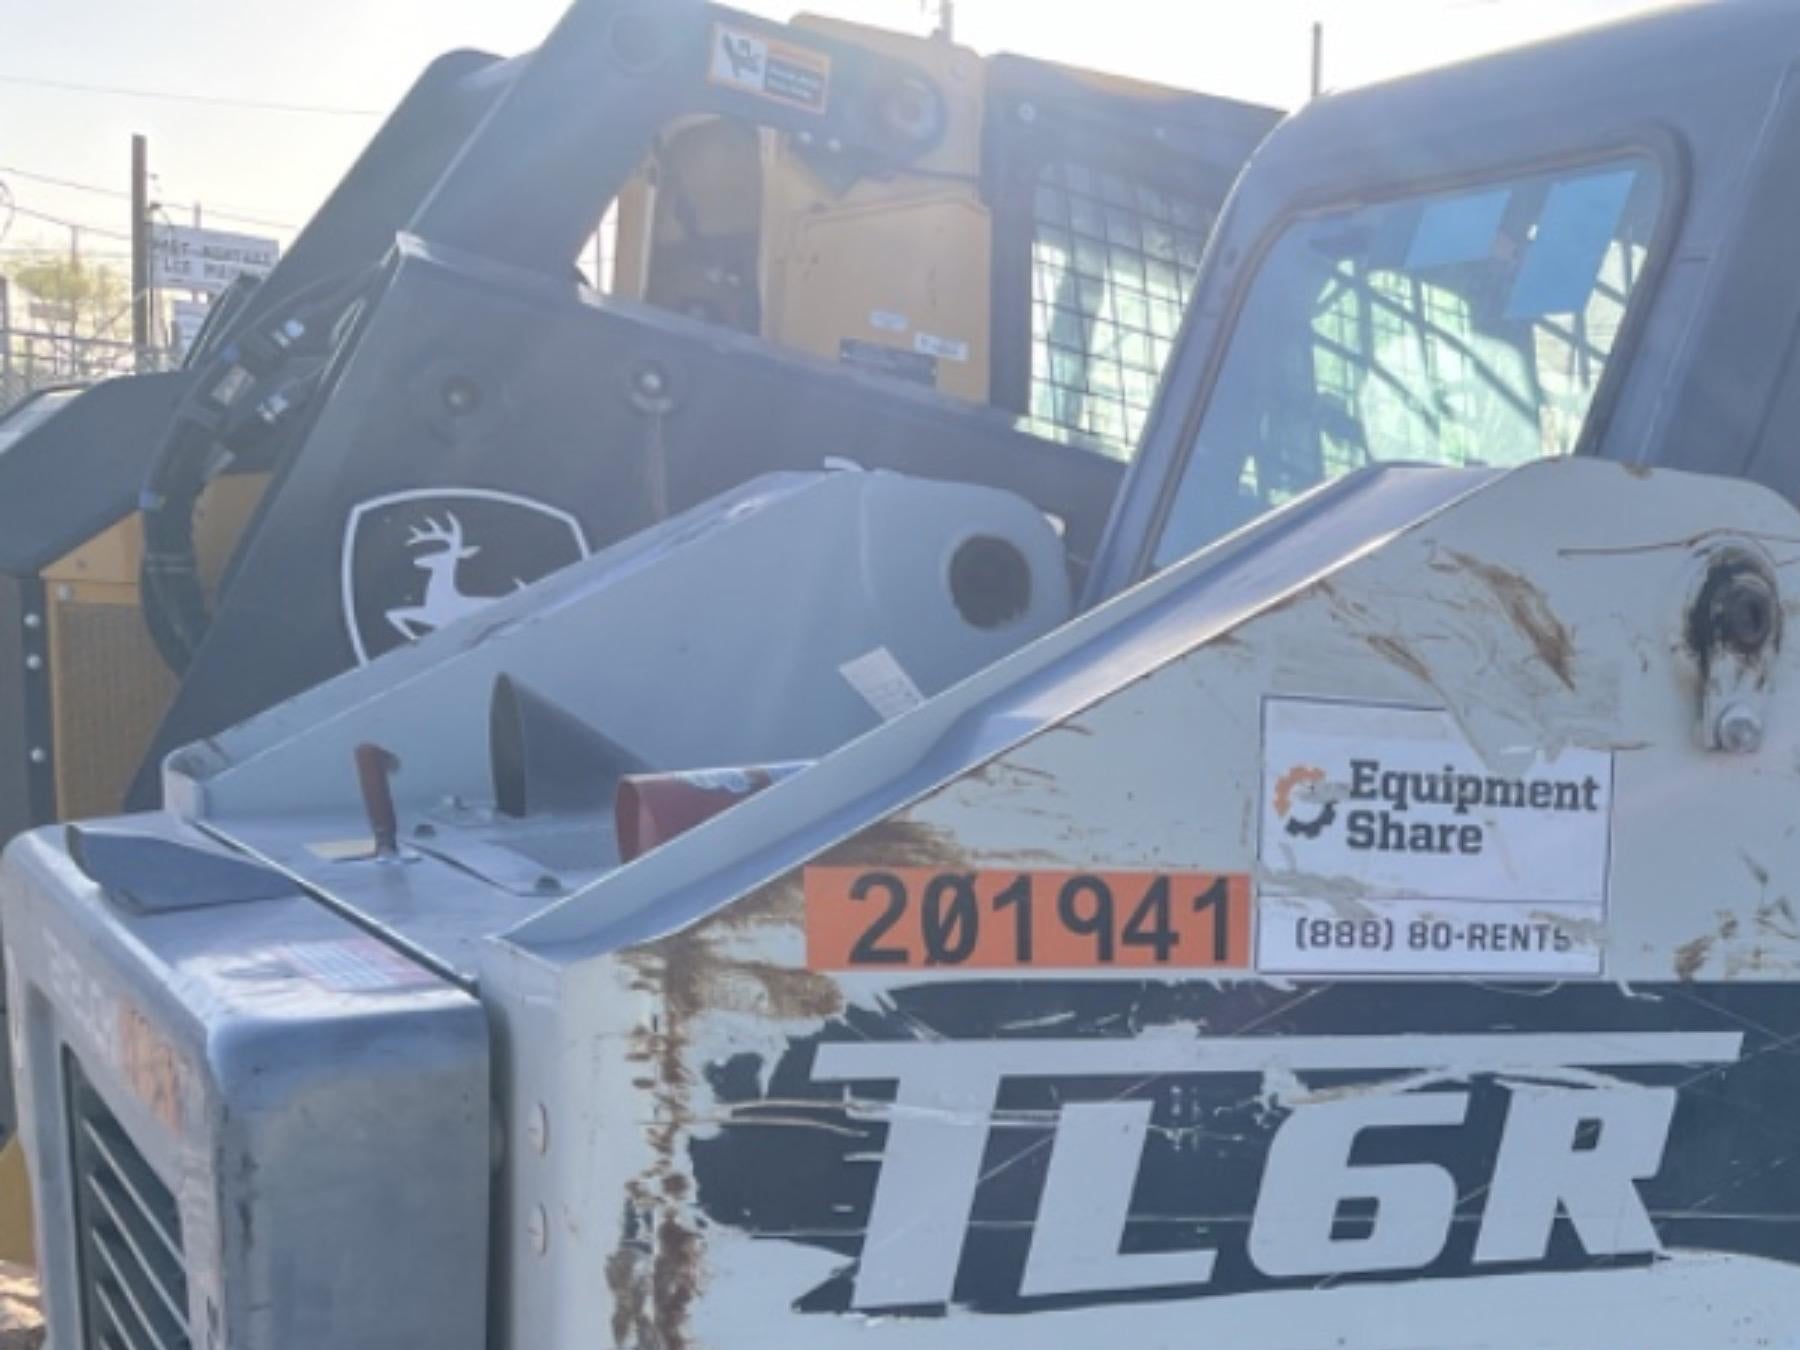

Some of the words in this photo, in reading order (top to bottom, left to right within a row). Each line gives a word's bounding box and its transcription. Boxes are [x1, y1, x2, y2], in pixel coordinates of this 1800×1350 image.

[1349, 759, 1600, 814] Equipment
[1346, 810, 1483, 855] Share
[849, 871, 1229, 965] 201941
[1295, 917, 1394, 951] (888)
[808, 1031, 1744, 1309] TL6R
